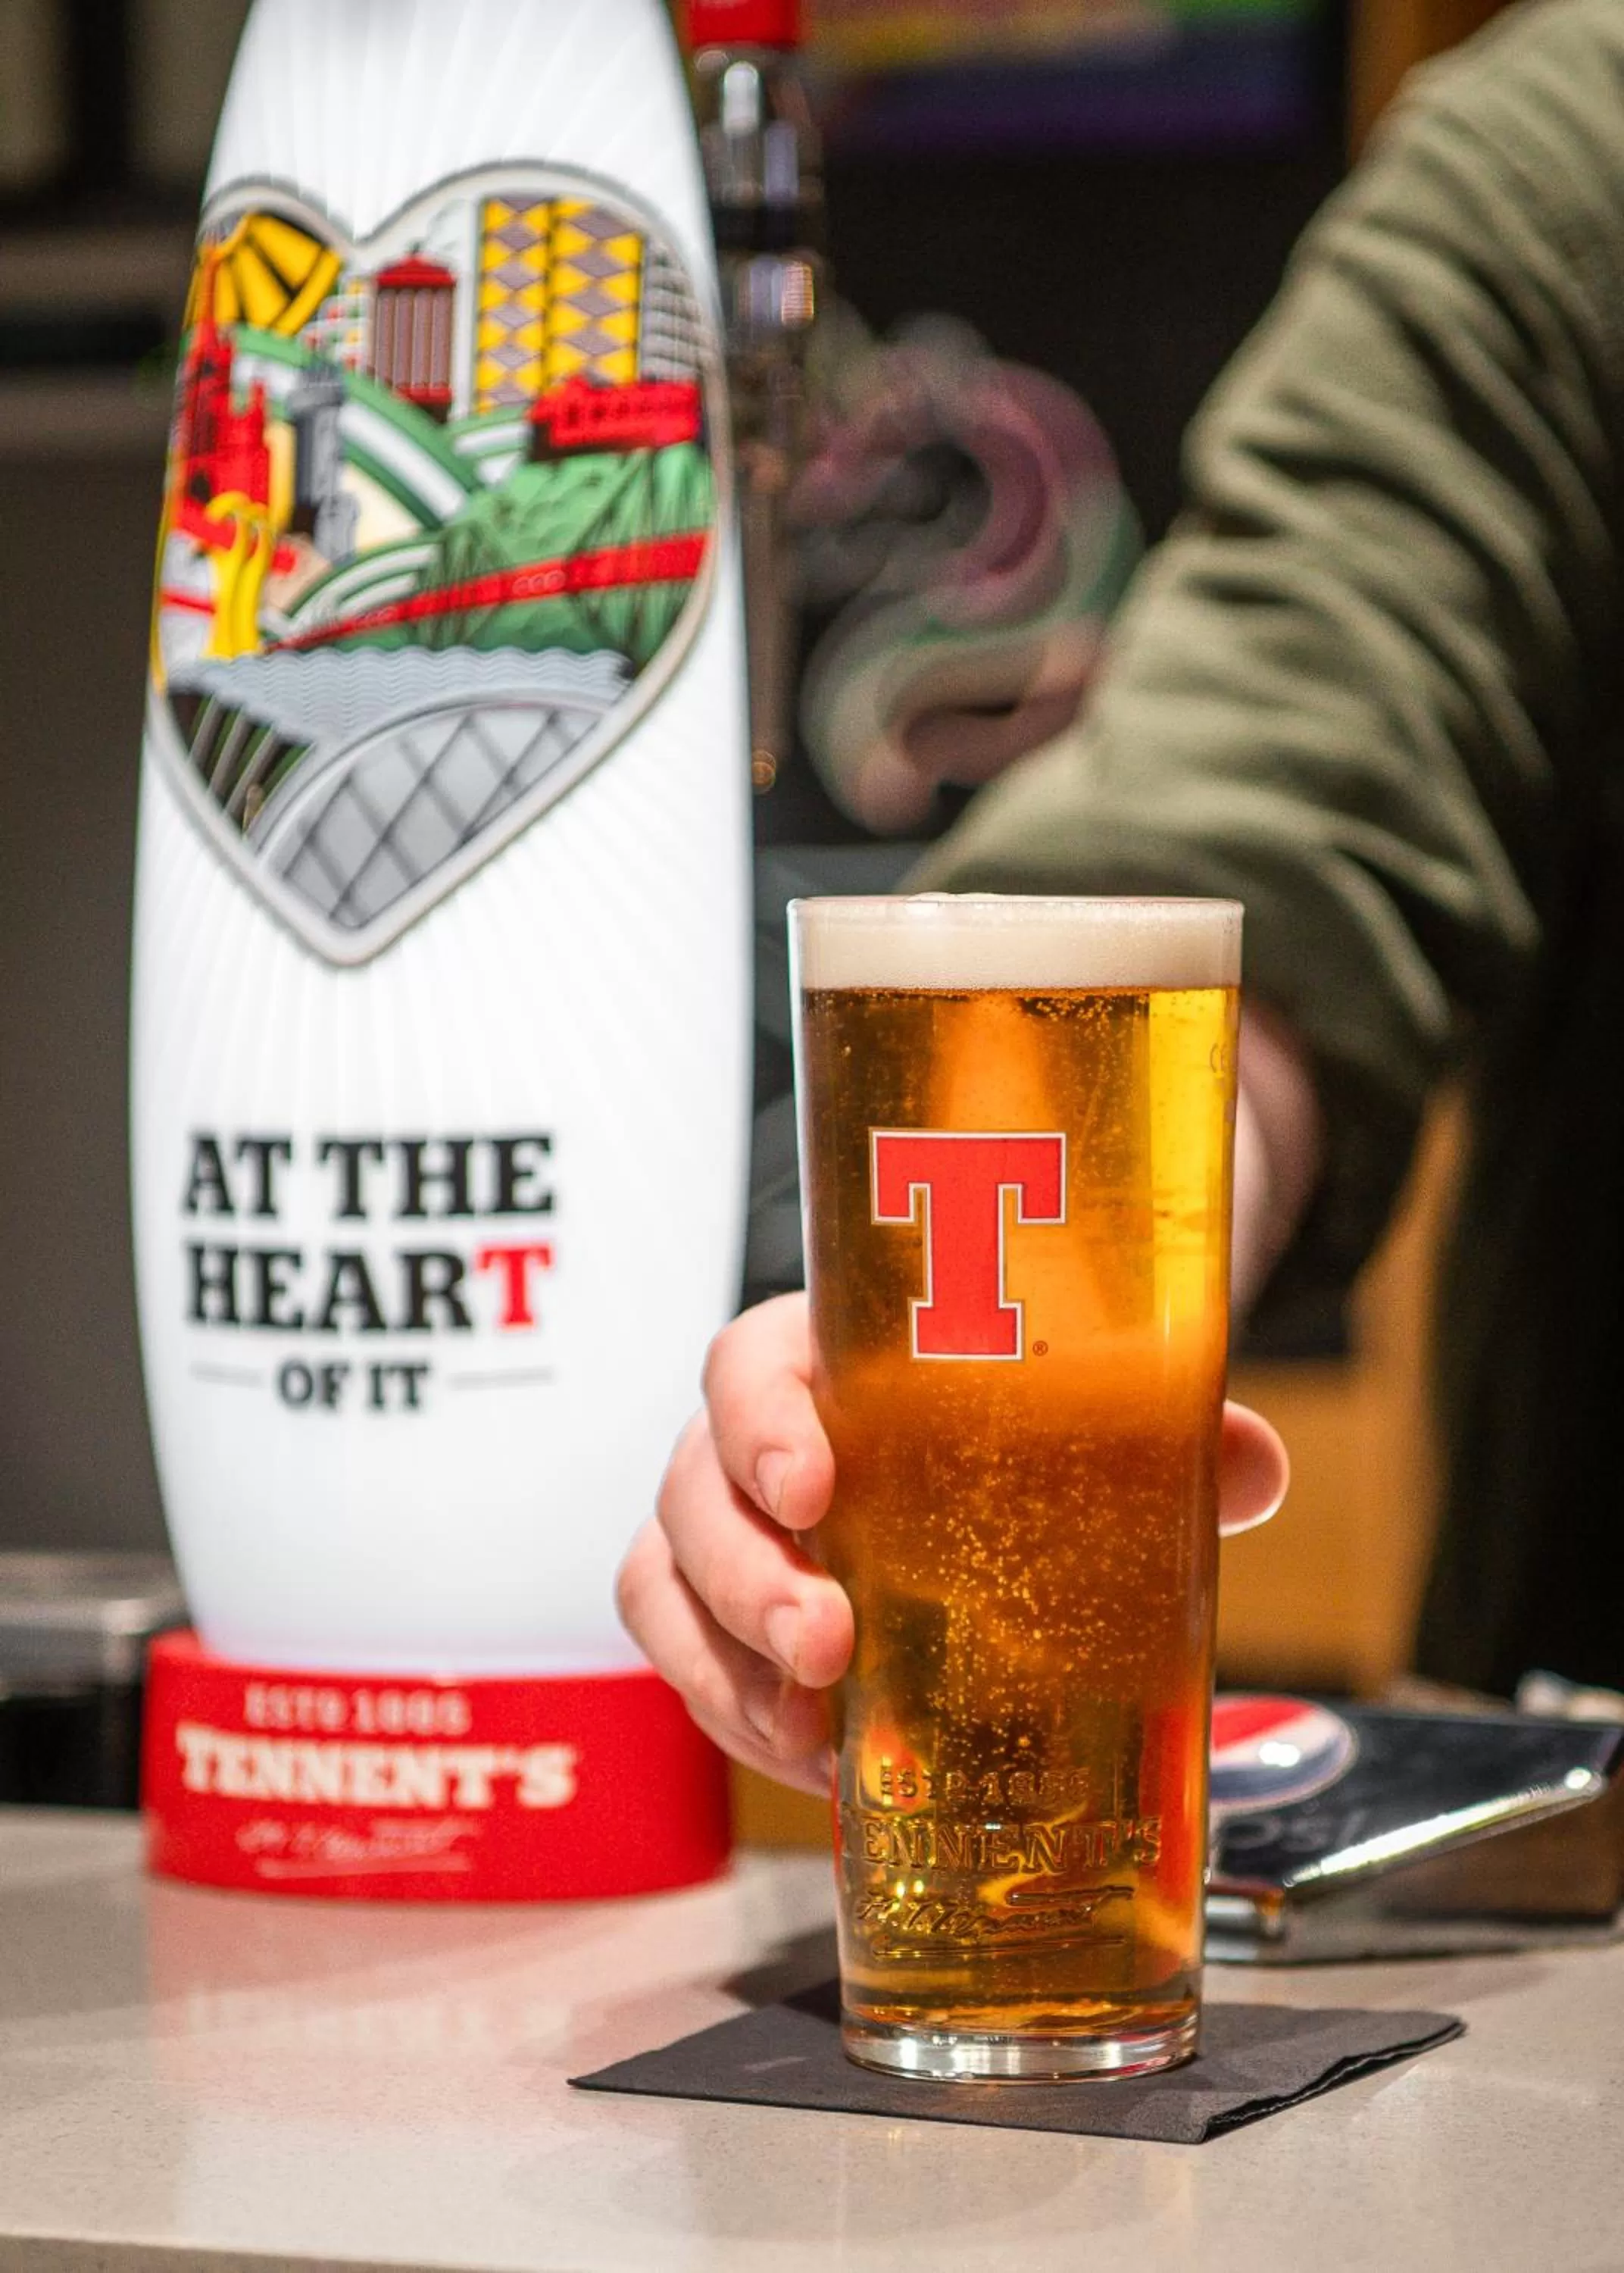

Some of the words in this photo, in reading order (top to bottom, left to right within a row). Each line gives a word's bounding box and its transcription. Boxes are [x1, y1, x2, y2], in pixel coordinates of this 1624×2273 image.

[184, 1132, 293, 1219] AT
[317, 1132, 555, 1220] THE
[186, 1239, 554, 1333] HEART
[870, 1129, 1066, 1361] T
[277, 1358, 349, 1412] OF
[366, 1358, 431, 1412] IT
[176, 1720, 580, 1809] TENNENT'S
[853, 1815, 1163, 1875] ENNENT'S
